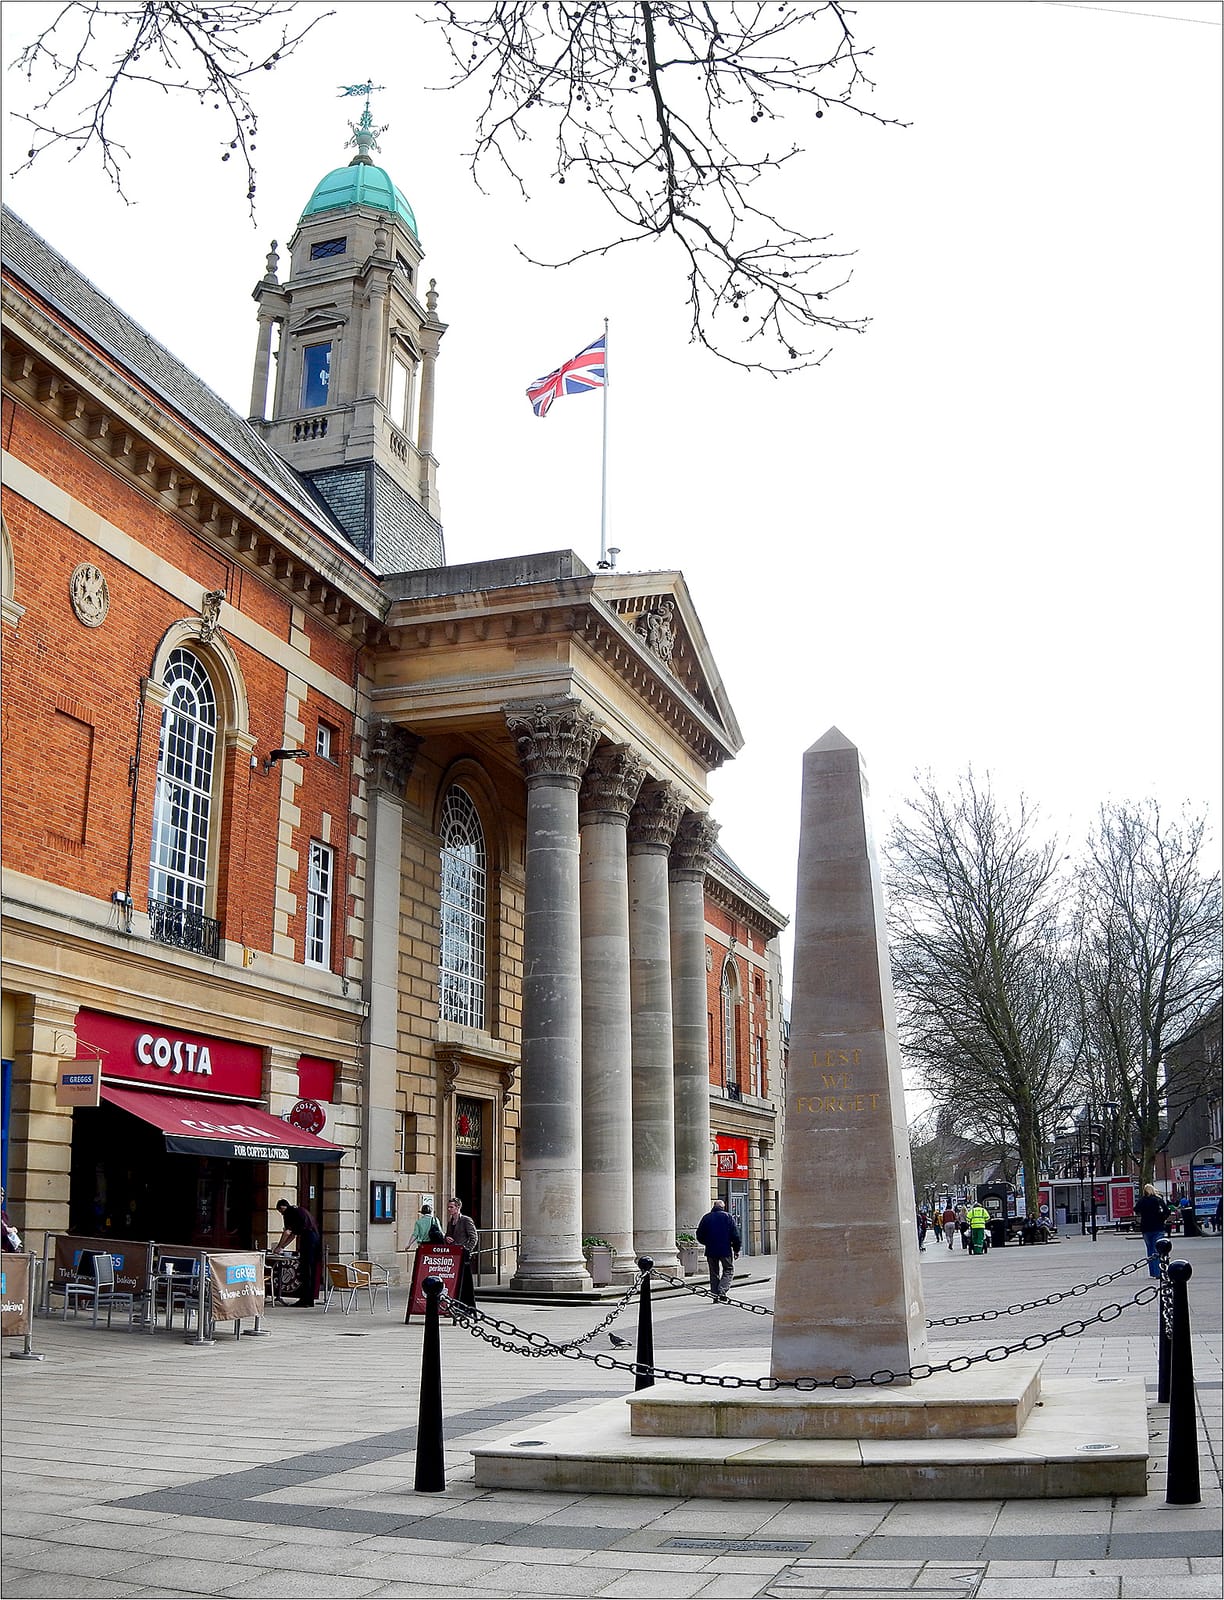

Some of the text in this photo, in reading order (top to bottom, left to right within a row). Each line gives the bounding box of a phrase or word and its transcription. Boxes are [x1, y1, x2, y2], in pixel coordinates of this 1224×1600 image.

[136, 1034, 213, 1075] COSTA
[811, 1049, 862, 1067] LEST
[69, 1075, 92, 1084] GREGGS
[822, 1072, 853, 1089] WE
[295, 1102, 317, 1113] COSTA
[797, 1093, 880, 1114] FORGET
[233, 1145, 289, 1159] FOR COFFEE LOVERS
[423, 1255, 454, 1267] Passion,
